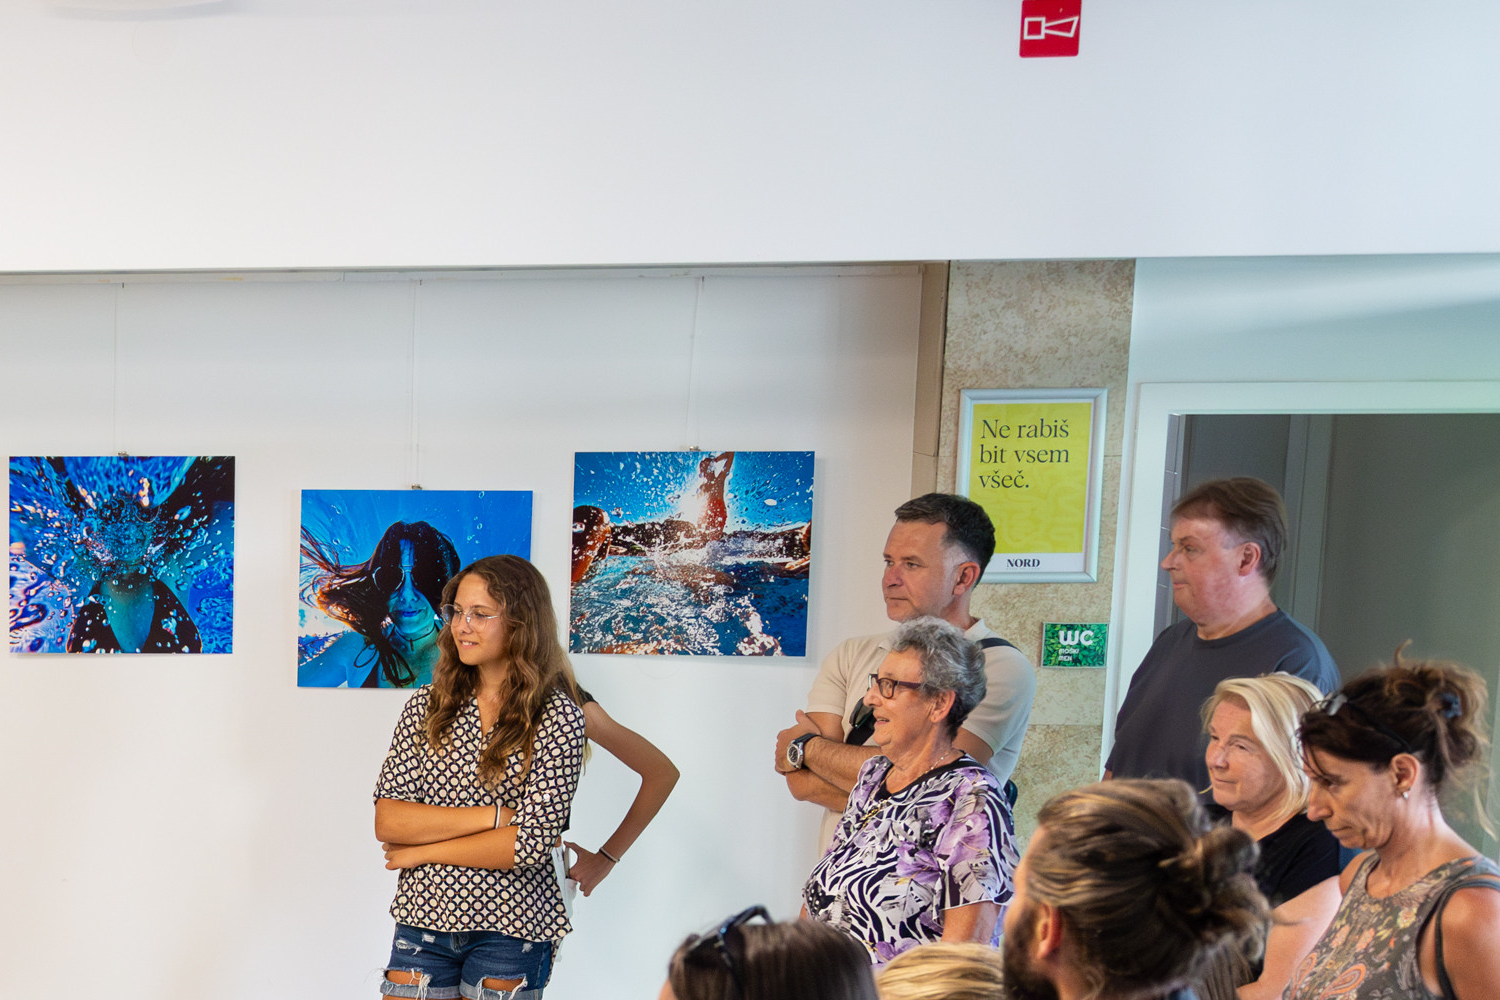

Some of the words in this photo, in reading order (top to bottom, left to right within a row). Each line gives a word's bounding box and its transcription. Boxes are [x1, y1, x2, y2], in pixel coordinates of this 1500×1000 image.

[981, 419, 1010, 438] Ne
[1017, 418, 1069, 438] rabiš
[980, 444, 1007, 463] bit
[1014, 450, 1069, 463] vsem
[978, 470, 1029, 488] všeč.
[1007, 559, 1040, 567] NORD
[1059, 630, 1094, 645] WC
